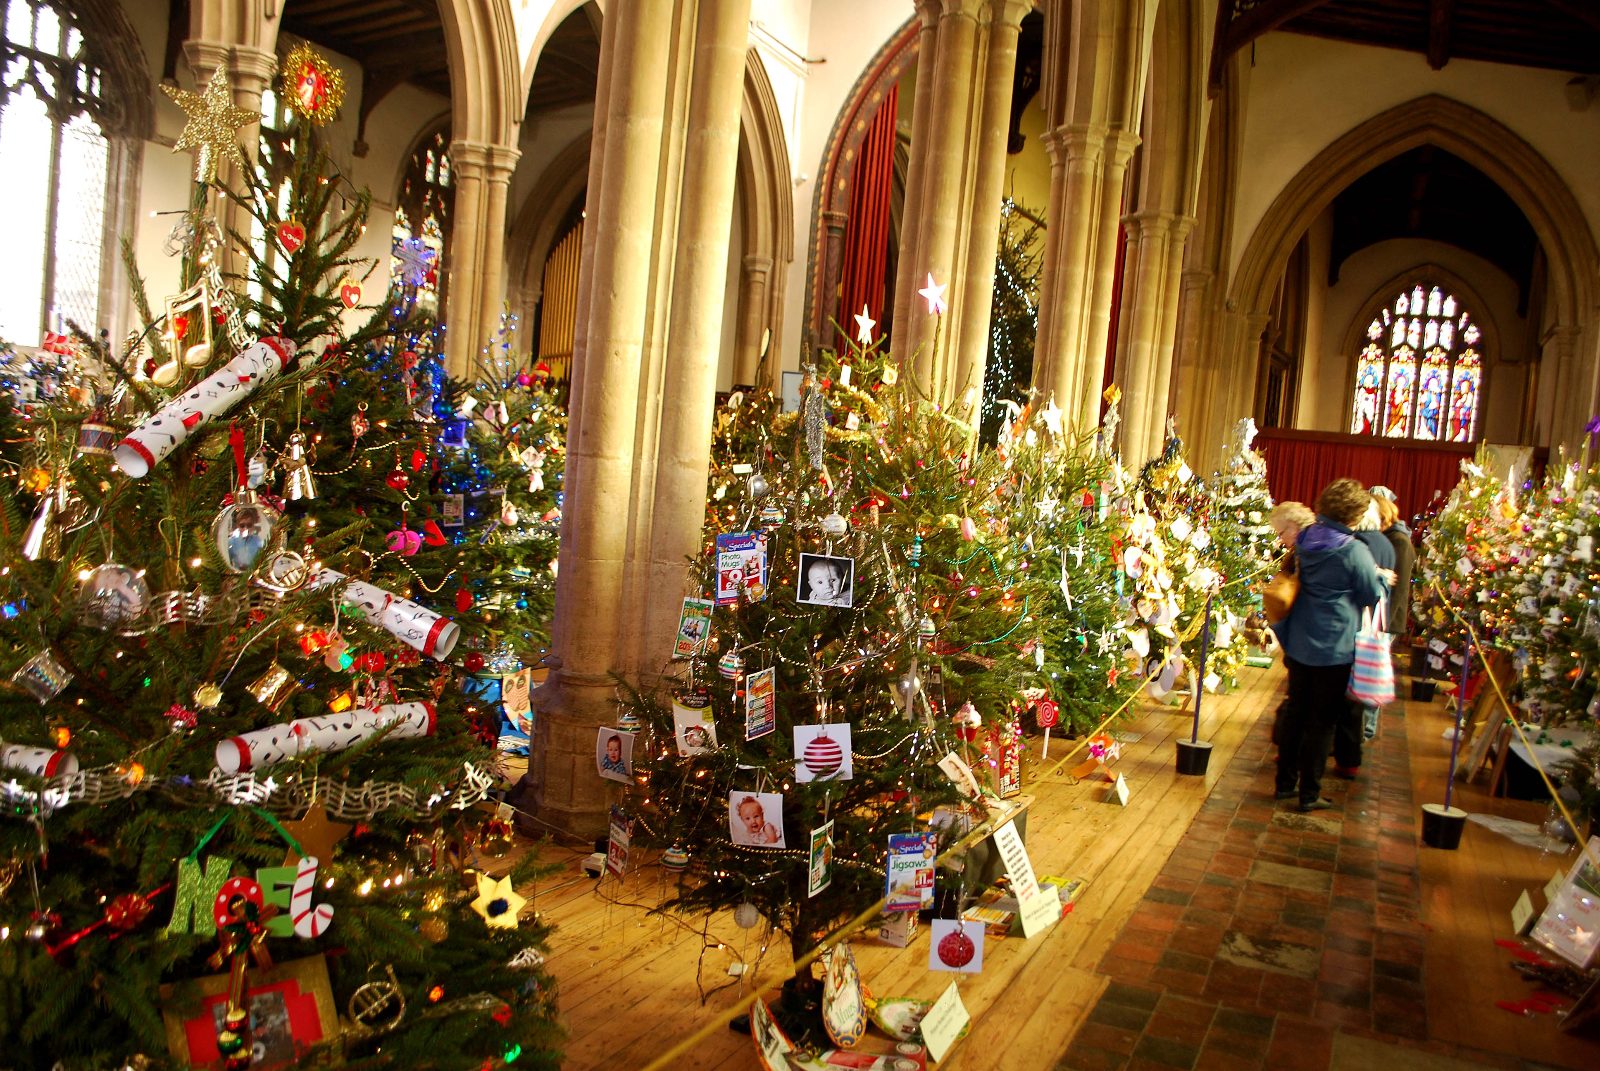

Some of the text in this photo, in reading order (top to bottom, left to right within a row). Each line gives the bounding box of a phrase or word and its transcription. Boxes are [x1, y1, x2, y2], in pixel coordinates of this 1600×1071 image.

[282, 230, 300, 245] LOVE
[728, 542, 753, 551] Specials
[892, 860, 927, 871] Jigsaws
[166, 855, 334, 938] NOEL
